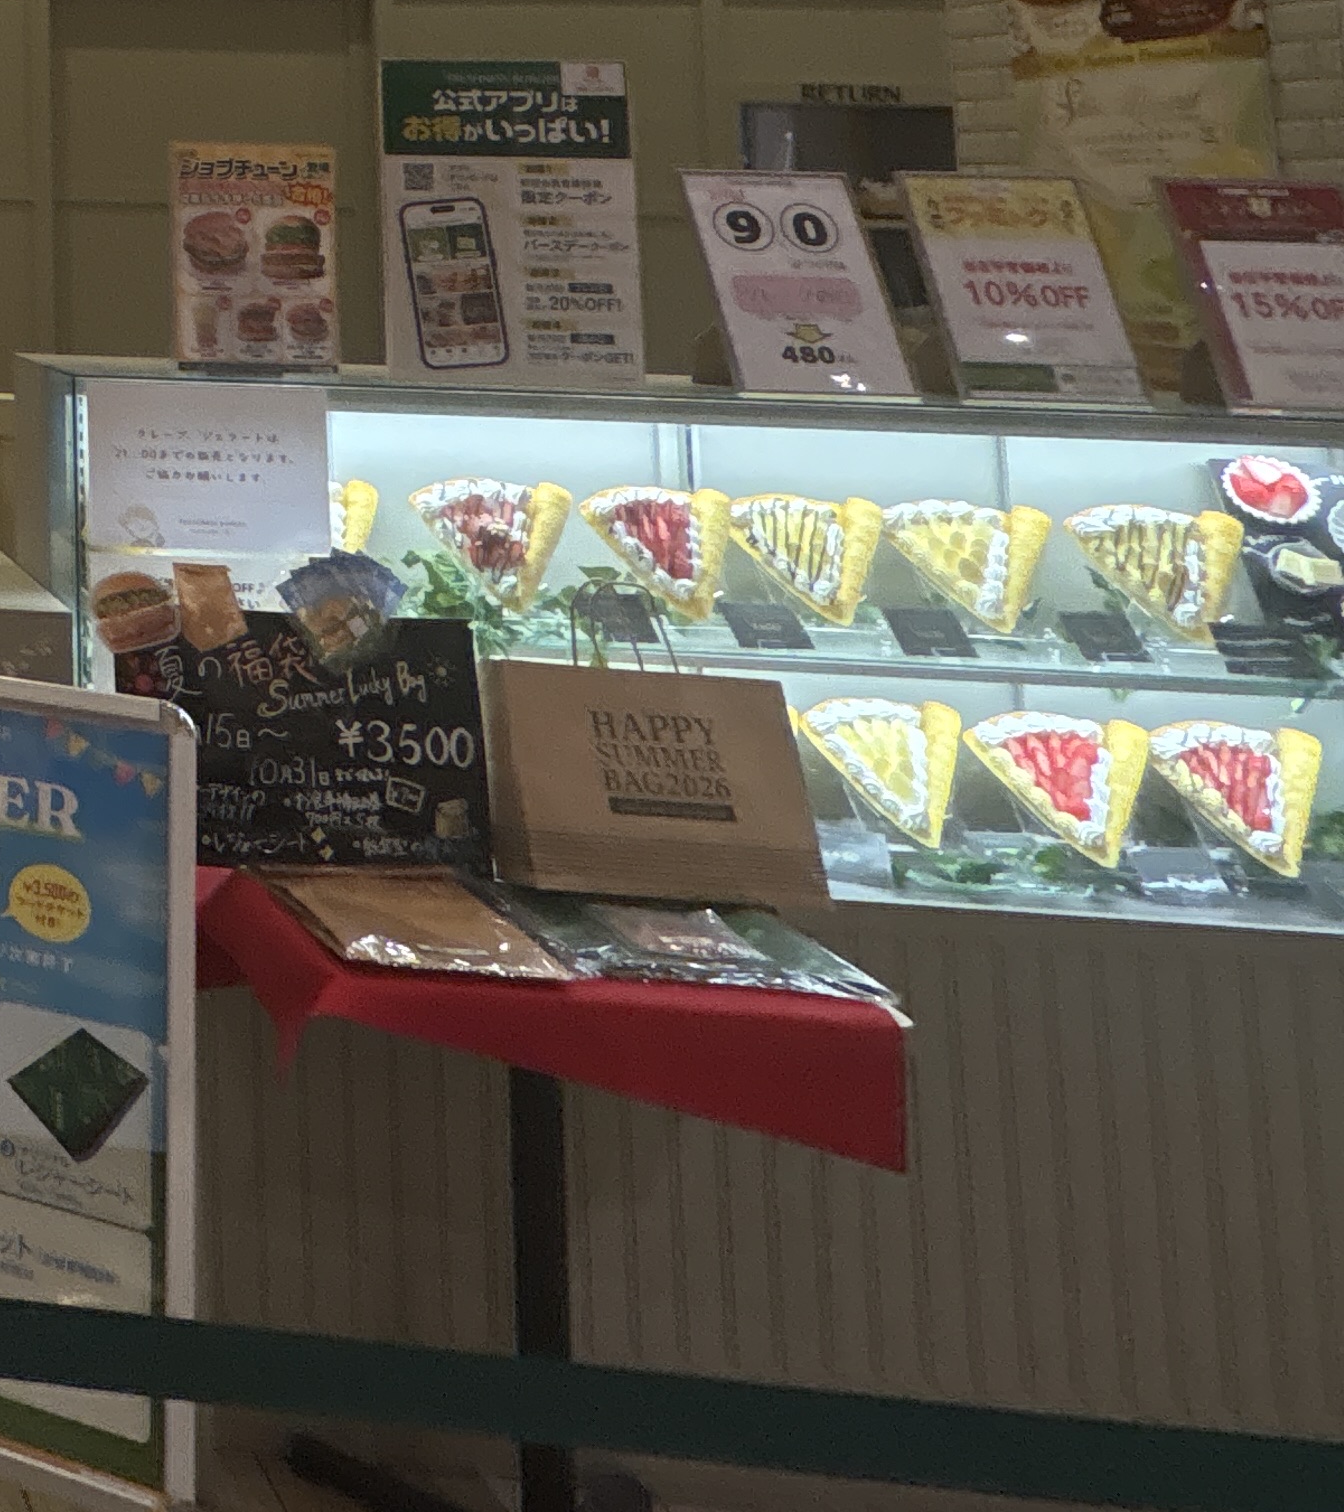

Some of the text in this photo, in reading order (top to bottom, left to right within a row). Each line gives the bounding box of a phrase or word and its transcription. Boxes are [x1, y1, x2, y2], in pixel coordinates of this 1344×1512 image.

[431, 88, 579, 113] 公式アプリは
[401, 115, 611, 144] お得がいっぱい!
[179, 158, 299, 181] ジョブチューン
[962, 279, 1090, 309] 10%OFF
[154, 633, 320, 701] 夏の福袋
[256, 678, 346, 719] Summer
[347, 667, 393, 706] Lucky
[588, 710, 714, 745] HAPPY
